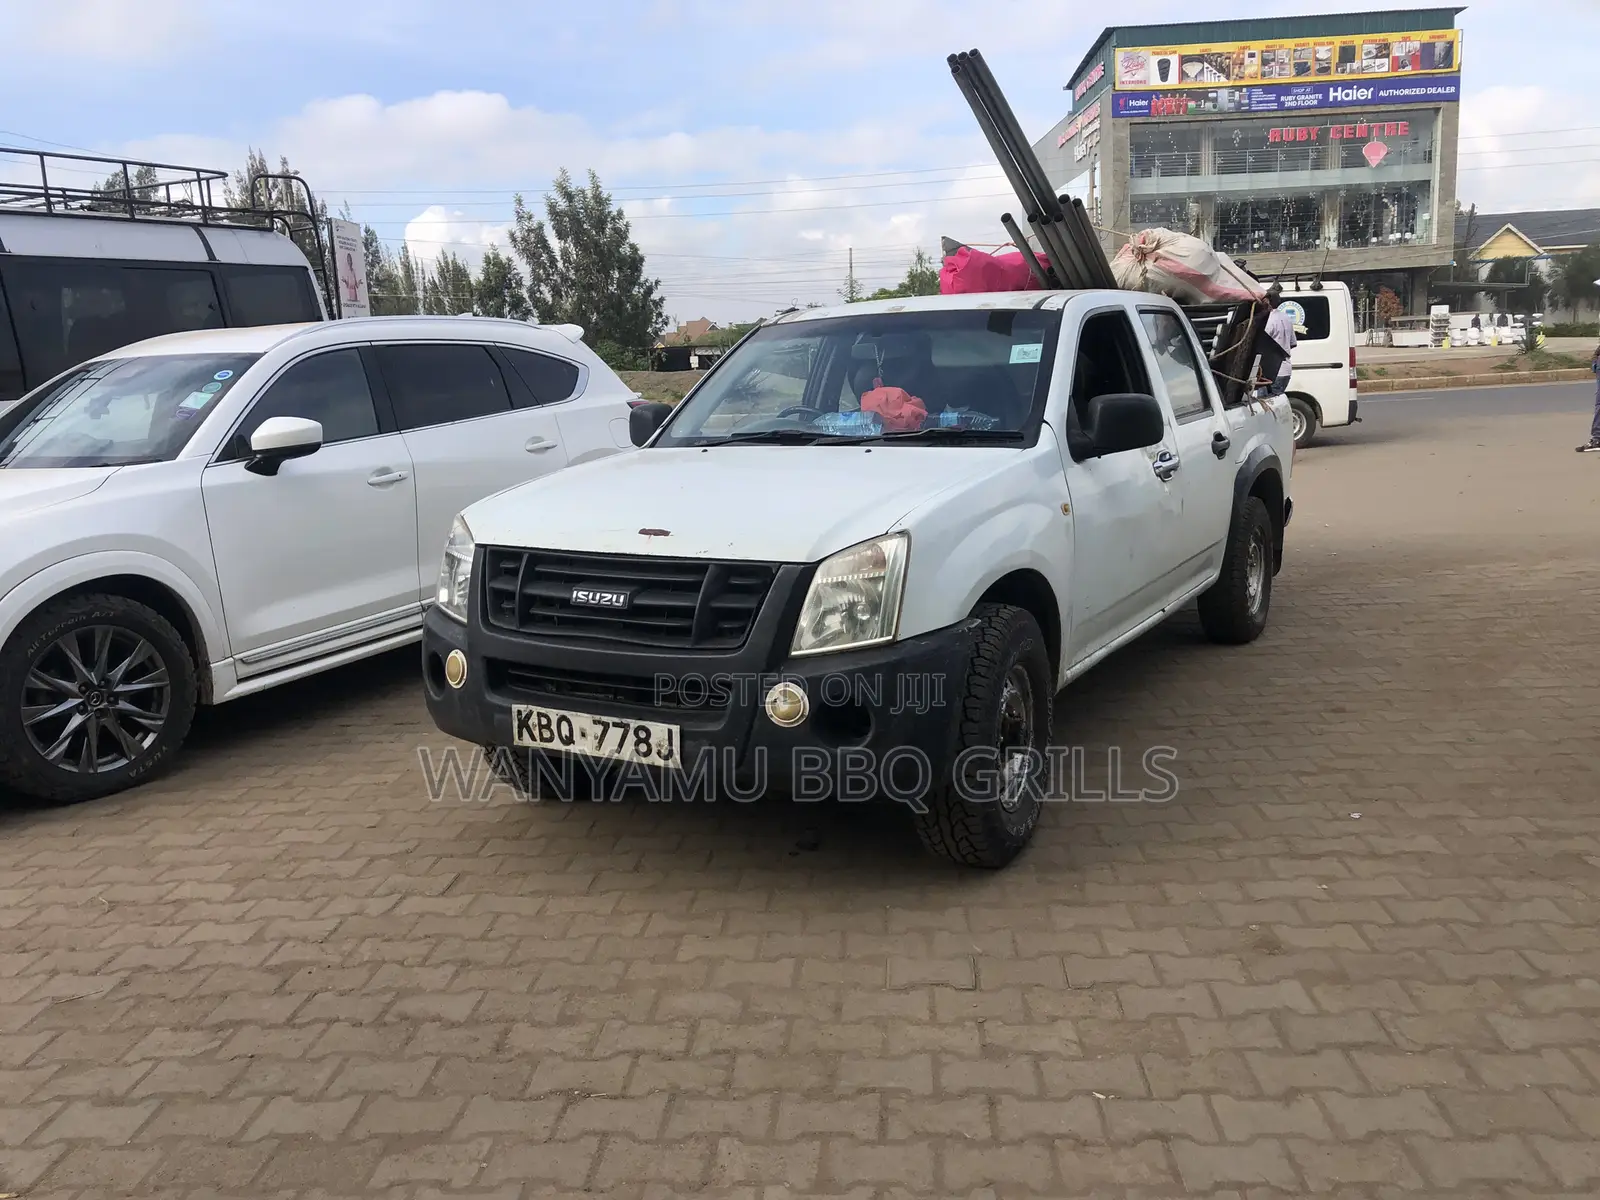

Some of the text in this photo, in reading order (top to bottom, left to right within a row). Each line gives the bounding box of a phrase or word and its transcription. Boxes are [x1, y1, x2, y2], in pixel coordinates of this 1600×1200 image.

[1297, 93, 1322, 101] GRANITE
[1328, 85, 1456, 101] Haier AUTHORIZED DEALER
[1129, 99, 1149, 107] Haier
[1269, 122, 1409, 142] RUBY CENTRE
[572, 590, 625, 607] ISUZU
[516, 708, 674, 761] KBQ 778J
